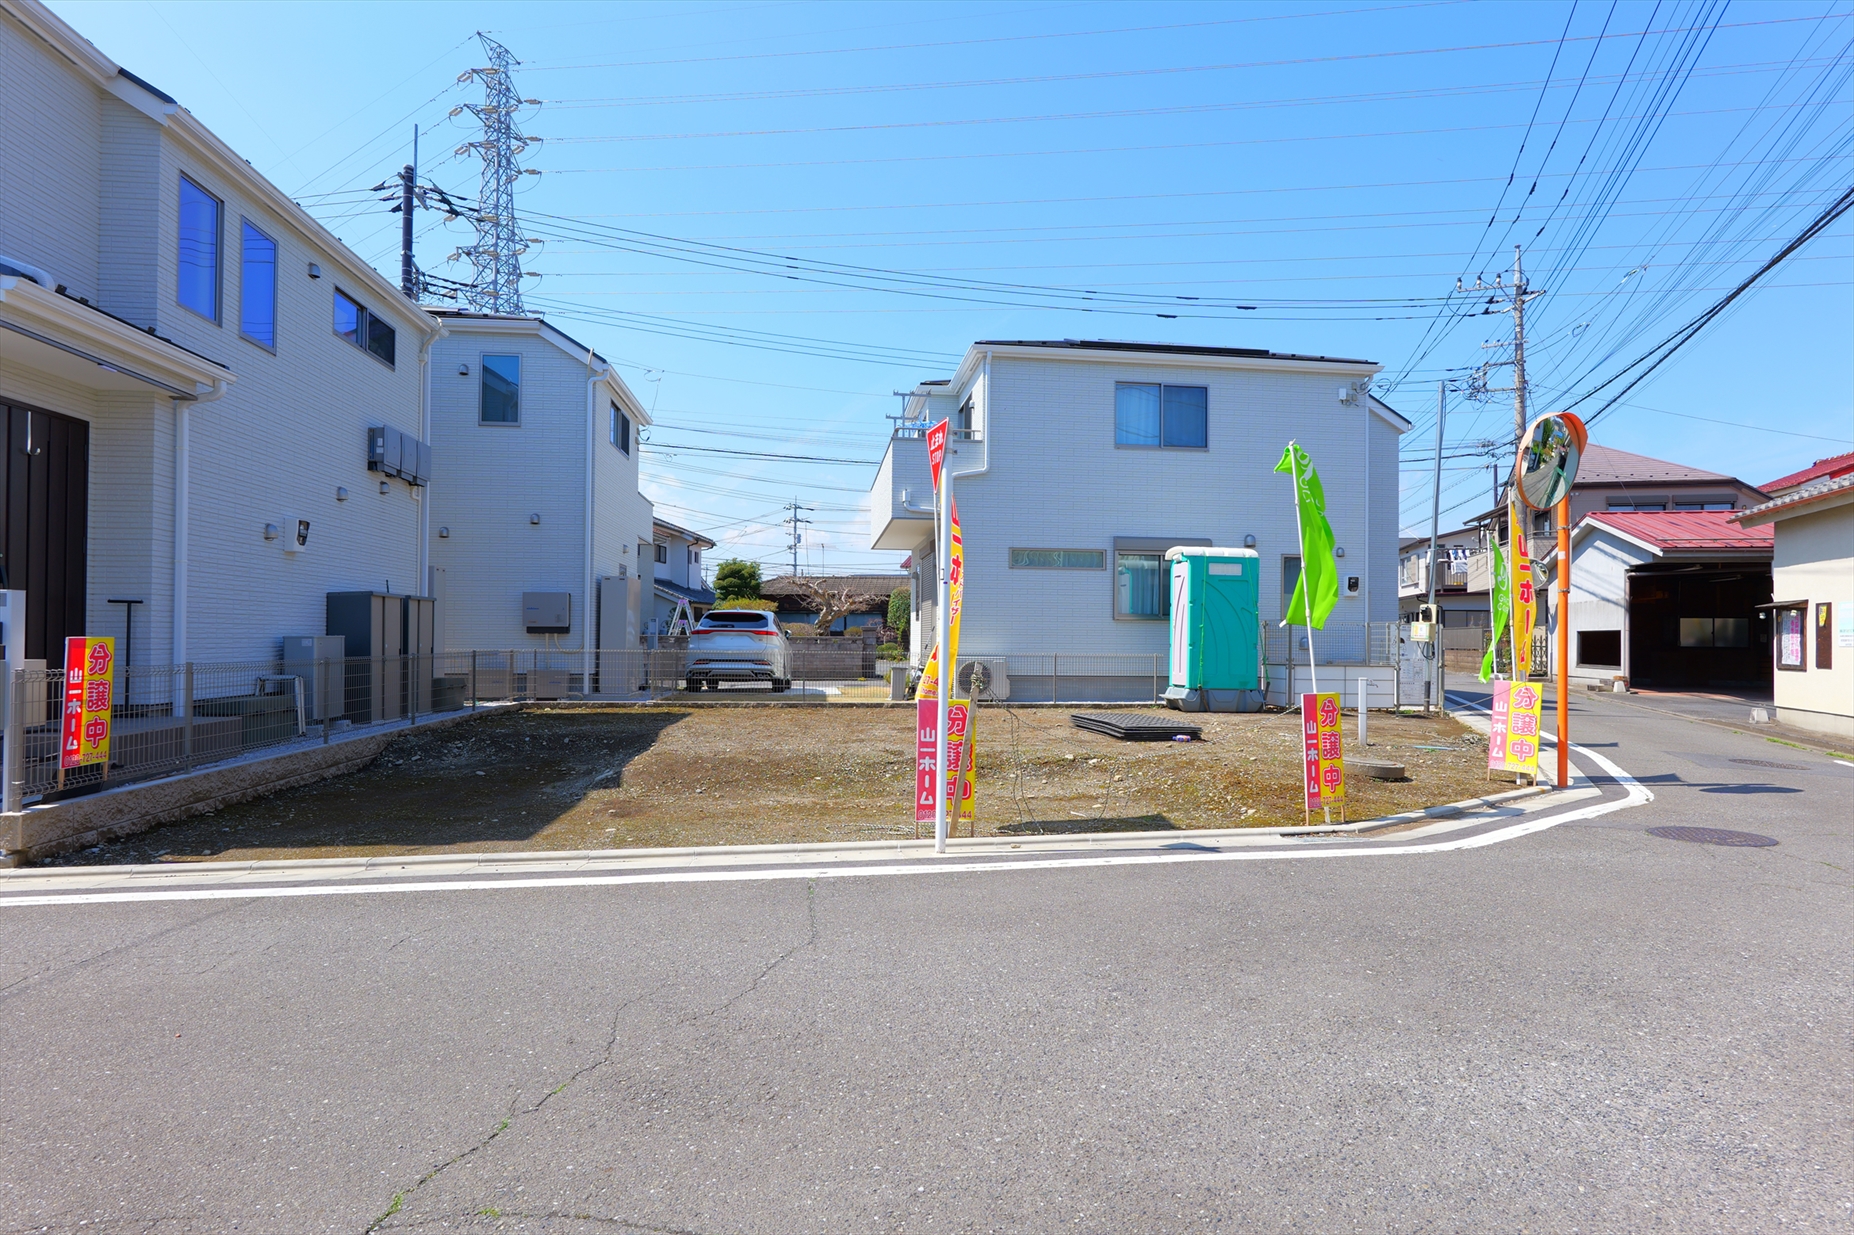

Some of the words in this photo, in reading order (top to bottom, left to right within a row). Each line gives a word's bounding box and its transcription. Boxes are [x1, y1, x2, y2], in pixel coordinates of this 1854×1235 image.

[930, 430, 944, 450] 止まれ
[931, 449, 942, 465] STOP
[66, 667, 82, 750] 山一ホーム
[85, 642, 112, 748] 分譲中
[1491, 701, 1508, 758] 山一ホーム
[1510, 686, 1539, 762] 分譲中
[64, 750, 107, 767] 0120-727-444
[919, 727, 937, 805] 山一ホーム
[1306, 720, 1319, 793] 山一ホーム
[1320, 697, 1342, 793] 分譲中
